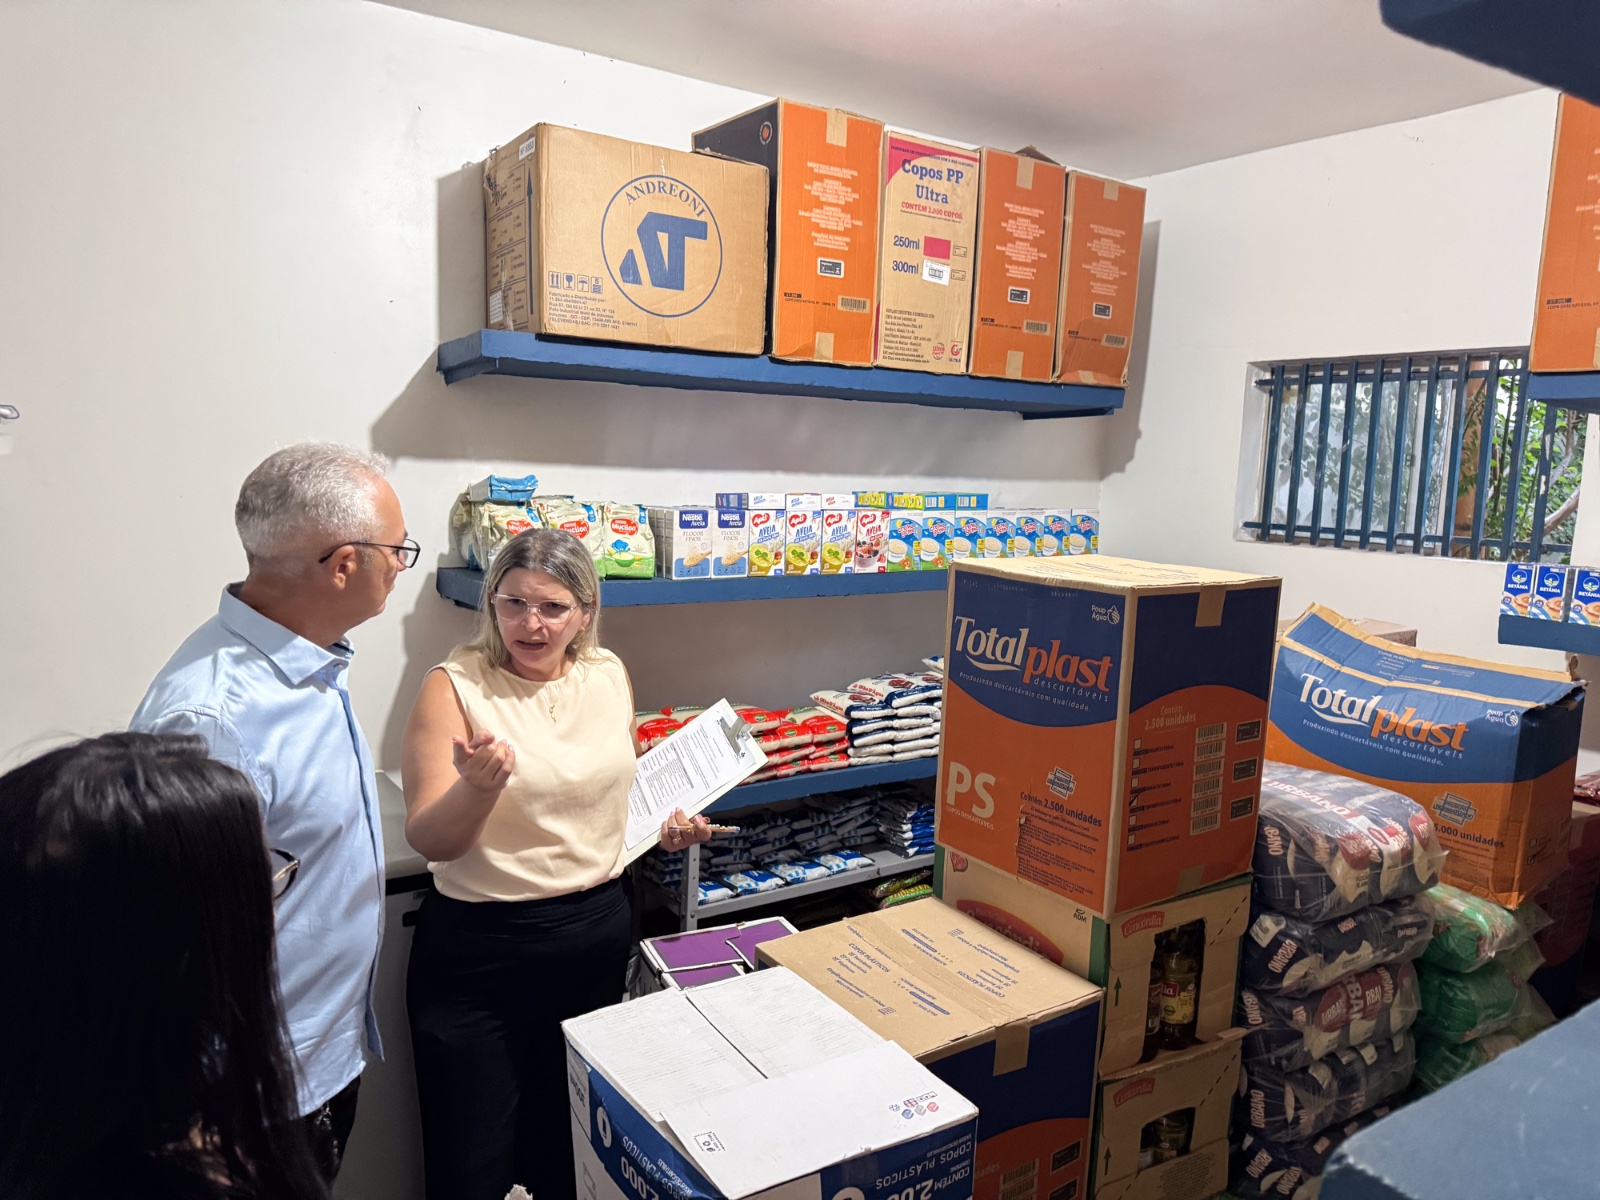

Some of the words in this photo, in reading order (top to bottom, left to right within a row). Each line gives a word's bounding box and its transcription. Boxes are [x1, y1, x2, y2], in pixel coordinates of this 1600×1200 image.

[901, 158, 943, 181] Copos
[946, 168, 964, 184] PP
[624, 180, 706, 218] ANDREONI
[916, 184, 948, 204] Ultra
[901, 200, 928, 213] CONTÉM
[943, 209, 963, 220] COPOS
[893, 235, 920, 250] 250ml
[892, 260, 918, 274] 300ml
[754, 514, 767, 525] Apti
[790, 514, 804, 525] Apti
[826, 514, 841, 524] Apti
[861, 514, 875, 524] Apti
[1091, 612, 1107, 622] Água
[1092, 605, 1106, 614] Poup
[959, 671, 993, 687] Produzindo
[993, 681, 1035, 698] descartáveis
[1036, 692, 1051, 701] com
[1052, 696, 1091, 712] qualidade.
[1034, 677, 1108, 702] descartáveis
[1144, 718, 1165, 730] 2.500
[1165, 713, 1196, 726] unidades
[1485, 715, 1505, 723] Água
[1302, 718, 1339, 736] Produzindo
[1340, 732, 1383, 750] descartáveis
[1385, 746, 1400, 755] com
[1402, 751, 1444, 766] qualidade.
[1382, 734, 1463, 759] descartáveis
[946, 761, 996, 820] PS
[1266, 780, 1350, 816] URBANO
[946, 805, 961, 817] COPOS
[961, 810, 994, 830] DESCARTÁVEIS
[1020, 792, 1042, 806] Contém
[1044, 798, 1064, 814] 2.500
[1066, 808, 1102, 827] unidades
[1460, 832, 1504, 848] unidades
[1073, 913, 1087, 923] ADM
[849, 942, 866, 955] COPOS
[864, 953, 890, 973] PLÁSTICOS
[956, 970, 985, 988] PLÁSTICOS
[984, 986, 1005, 998] COPOS
[1250, 1088, 1265, 1128] URBANO
[622, 1136, 660, 1180] PLÁSTICOS
[940, 1141, 972, 1164] COPOS
[876, 1158, 935, 1189] PLÁSTICOS
[934, 1166, 970, 1190] CONTÉM
